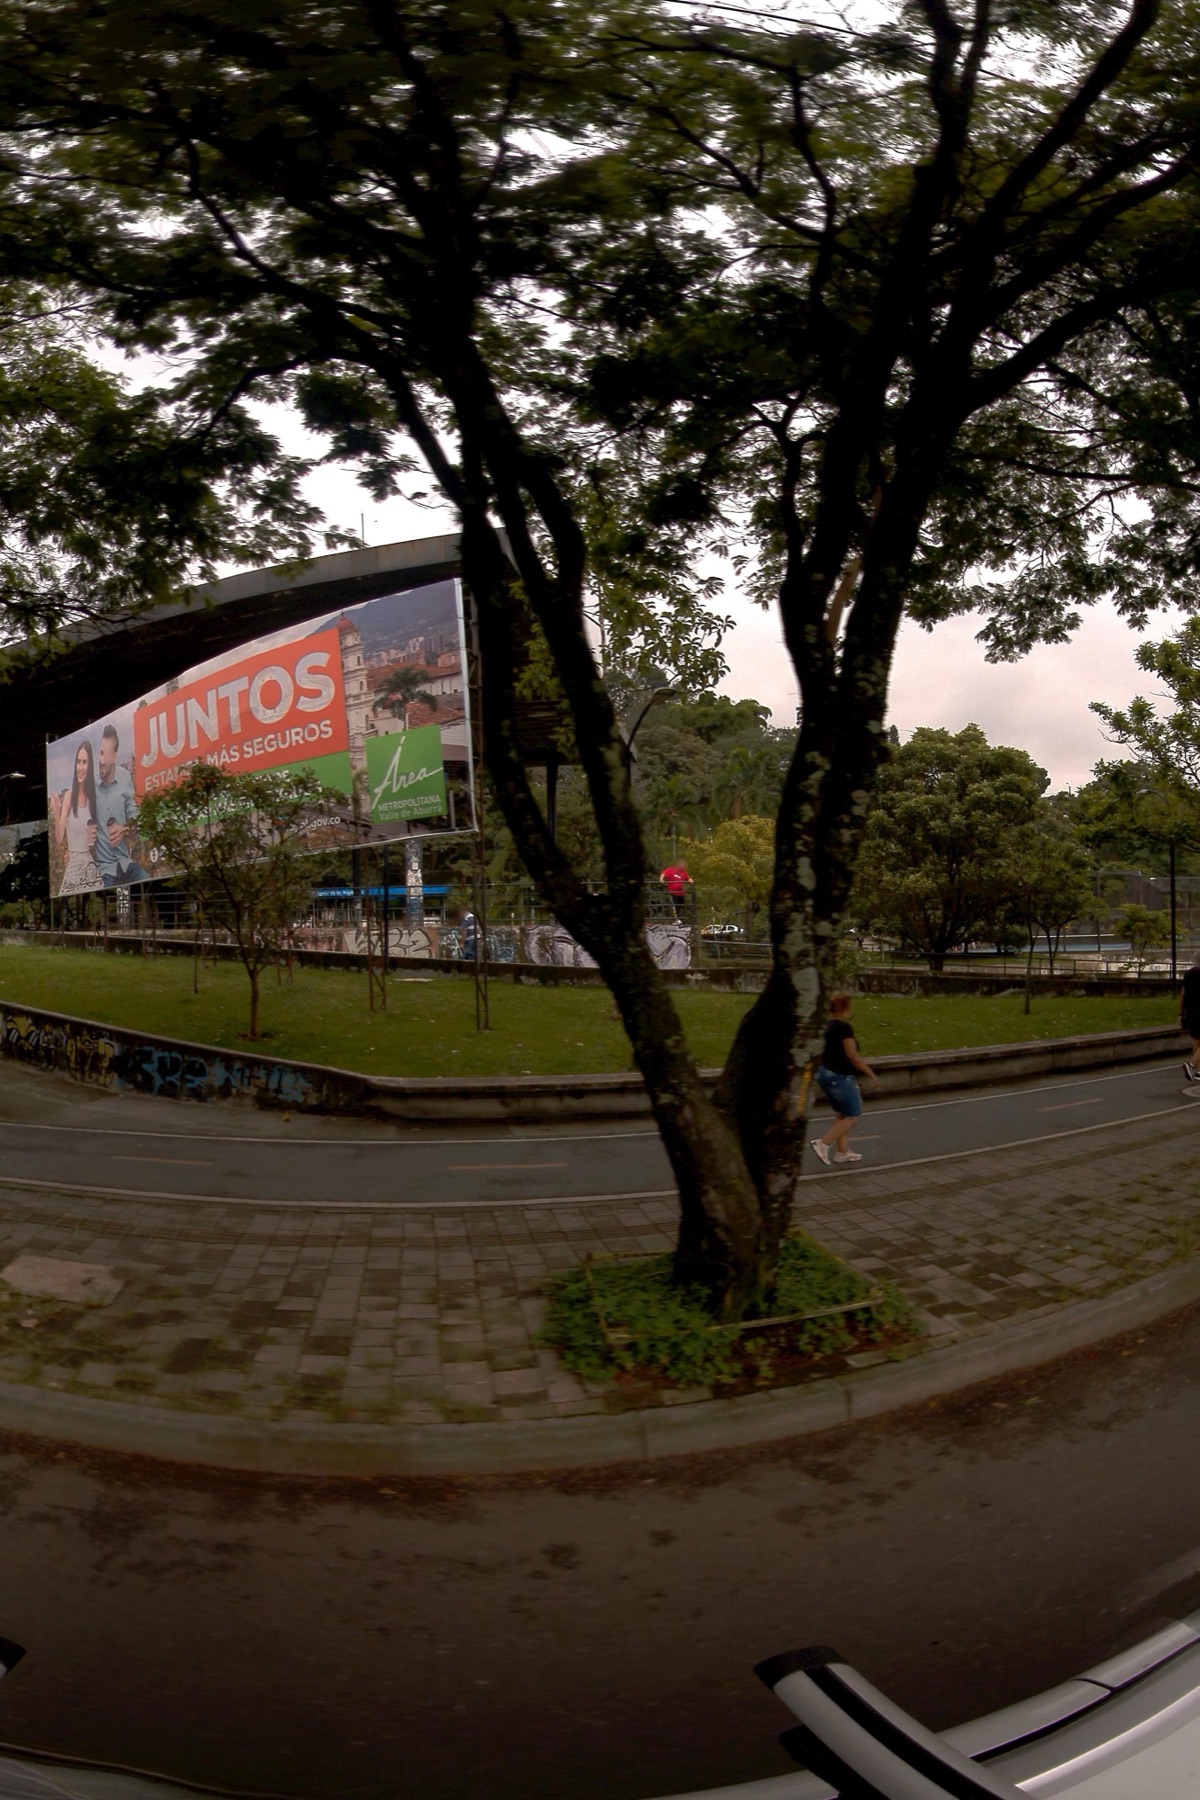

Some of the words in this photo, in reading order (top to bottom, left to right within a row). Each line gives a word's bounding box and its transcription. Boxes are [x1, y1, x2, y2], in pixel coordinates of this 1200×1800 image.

[140, 651, 336, 768] JUNTOS
[206, 744, 239, 767] MÁS
[243, 719, 333, 759] SEGUROS
[371, 735, 444, 810] Área
[378, 794, 442, 812] METROPOLITANA
[379, 810, 399, 821] Valle
[401, 806, 411, 817] de
[413, 802, 442, 816] Aburrá
